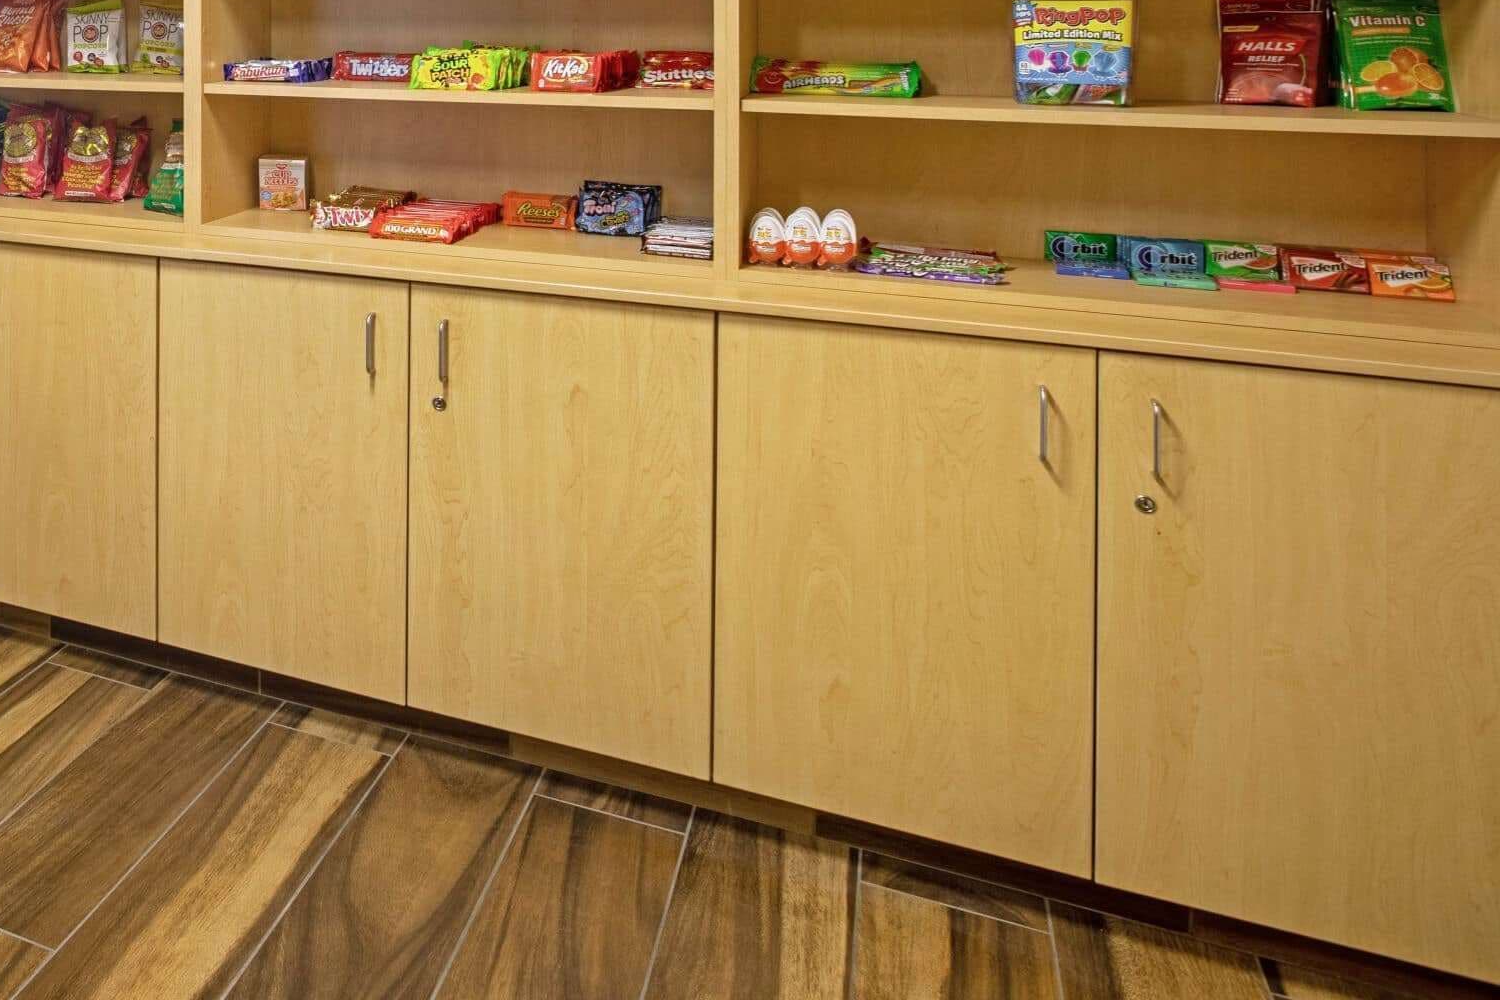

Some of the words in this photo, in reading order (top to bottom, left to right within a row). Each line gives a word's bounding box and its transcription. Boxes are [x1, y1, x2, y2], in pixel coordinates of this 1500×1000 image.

[74, 12, 110, 25] SKINNY
[146, 8, 181, 22] SKINNY
[1350, 15, 1411, 28] Vitamin
[1415, 16, 1426, 27] C
[72, 24, 109, 43] POP
[142, 20, 178, 41] POP
[1023, 29, 1061, 40] Limited
[1063, 29, 1100, 40] Edition
[1102, 30, 1123, 41] Mix
[1238, 41, 1296, 52] HALLS
[432, 59, 469, 71] SOUR
[1247, 55, 1285, 63] RELIEF
[349, 58, 410, 77] Twizzlers
[431, 69, 470, 81] PATCH
[643, 68, 716, 83] Skittles
[783, 74, 845, 90] AIRHEADS
[516, 202, 561, 218] Reese's
[384, 223, 400, 233] 100
[400, 224, 438, 236] GRAND
[1212, 249, 1258, 263] Trident
[1295, 262, 1346, 275] Trident
[1377, 269, 1430, 282] Trident
